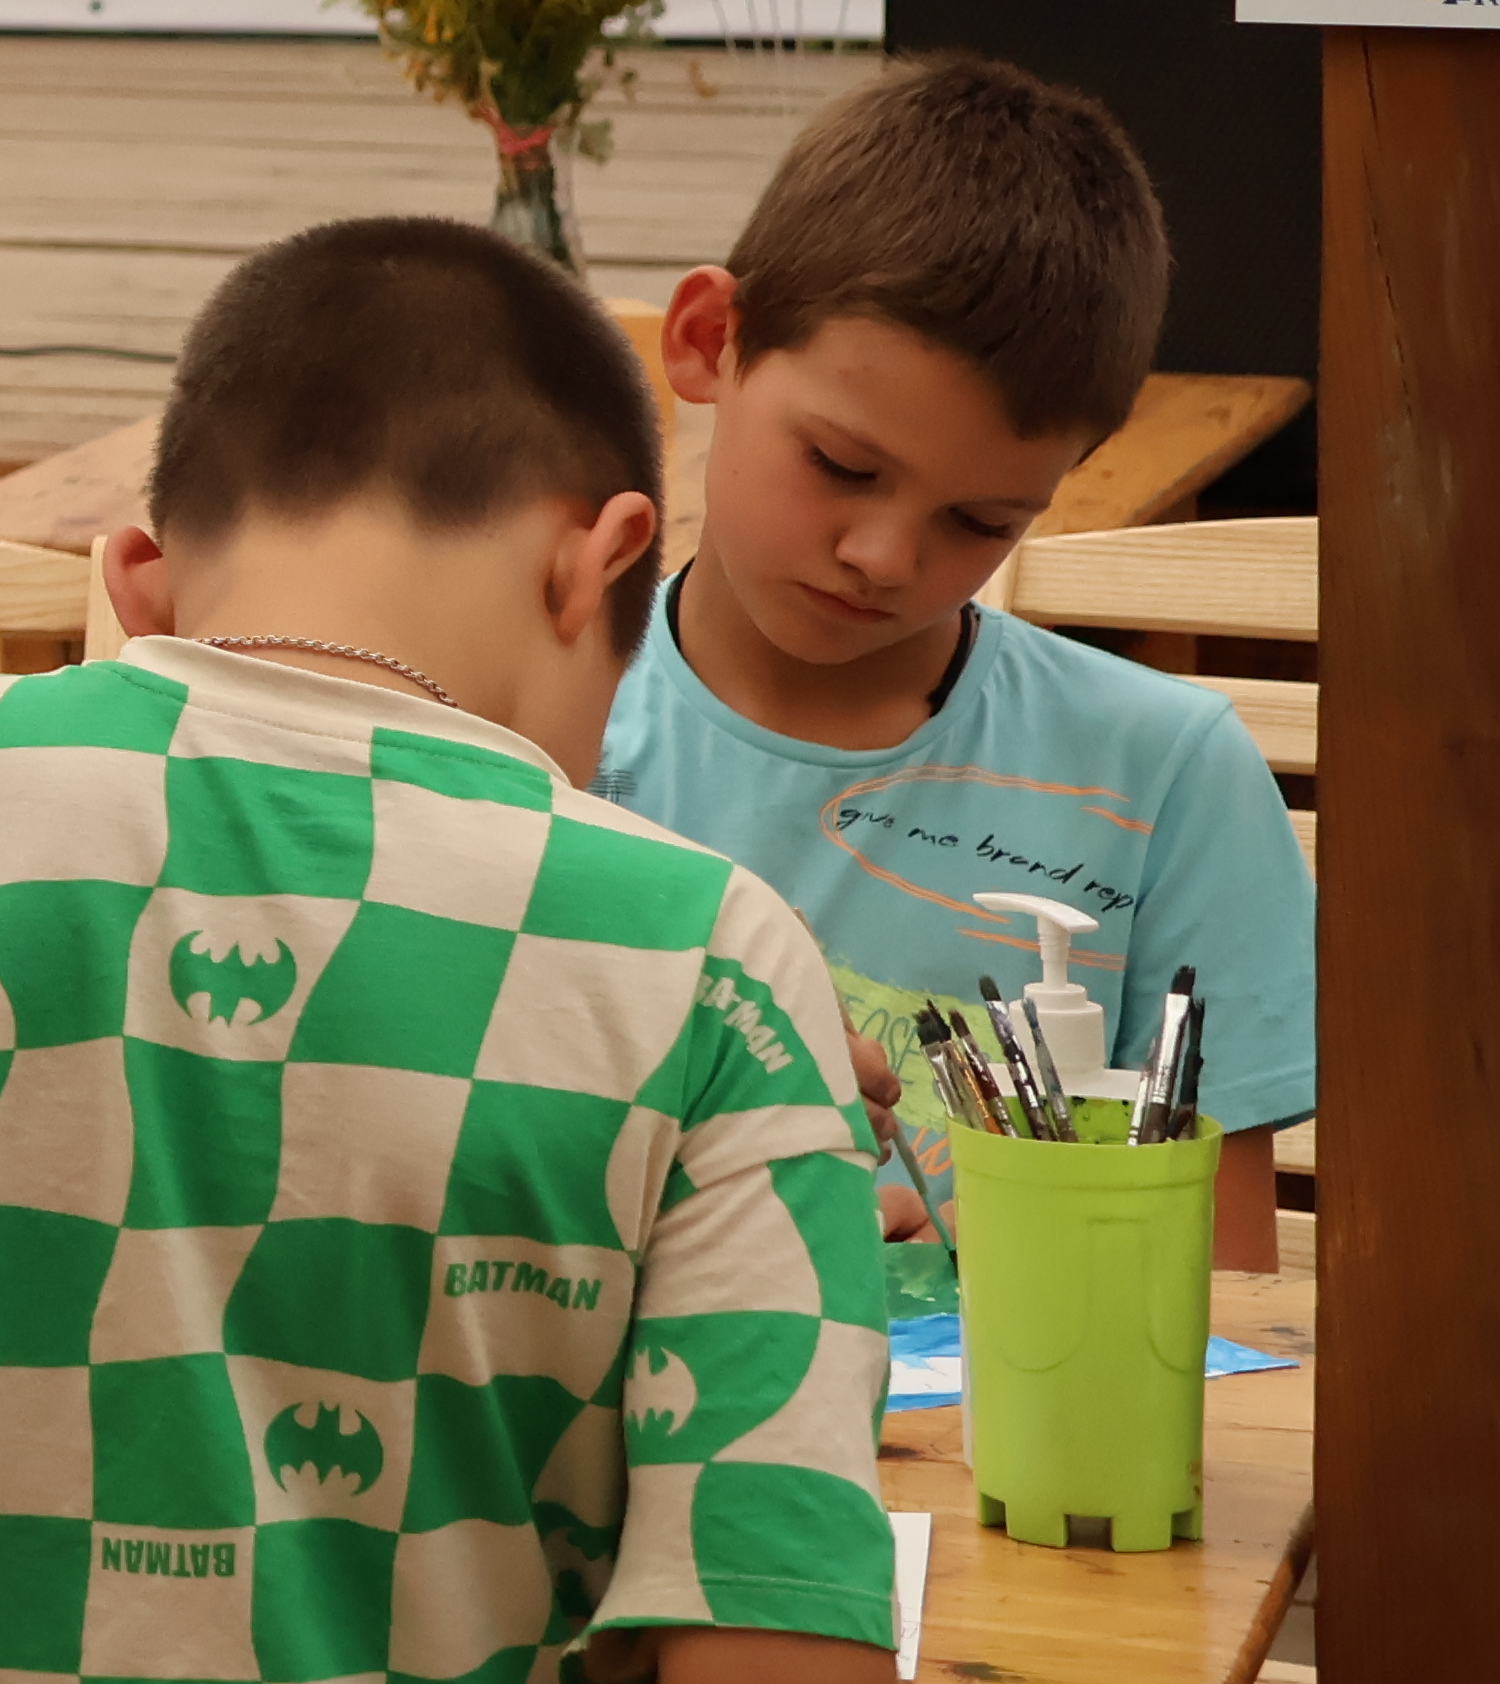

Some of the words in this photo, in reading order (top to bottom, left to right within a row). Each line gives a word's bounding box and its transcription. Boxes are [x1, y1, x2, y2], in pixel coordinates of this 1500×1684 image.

[907, 825, 960, 849] me
[976, 833, 1084, 886] brand
[696, 974, 793, 1074] BATMAN
[445, 1261, 602, 1311] BATMAN
[102, 1537, 236, 1578] BATMAN
